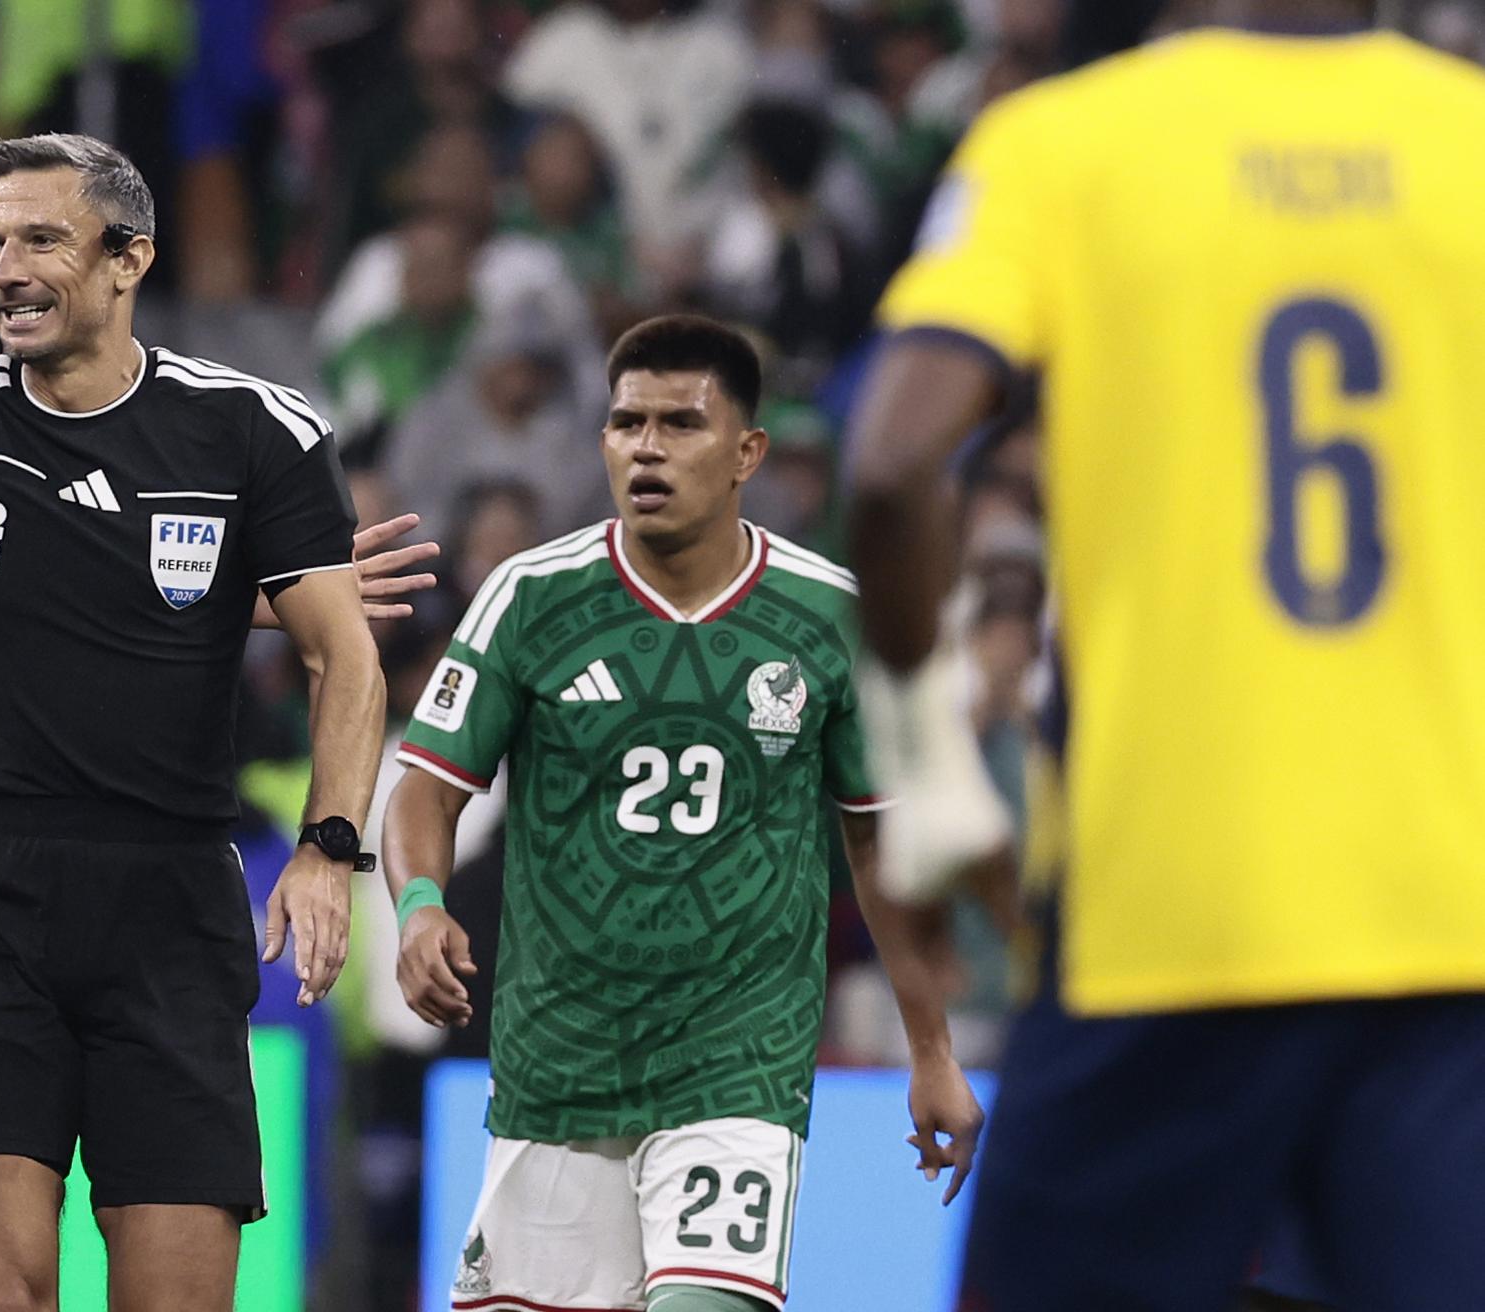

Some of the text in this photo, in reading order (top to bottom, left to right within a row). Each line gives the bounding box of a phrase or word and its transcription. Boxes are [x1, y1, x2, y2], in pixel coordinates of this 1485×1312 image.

[1259, 291, 1389, 629] 6
[159, 521, 217, 546] FIFA
[158, 558, 212, 573] REFEREE
[170, 590, 195, 601] 2026
[616, 744, 725, 835] 23
[676, 1165, 772, 1254] 23
